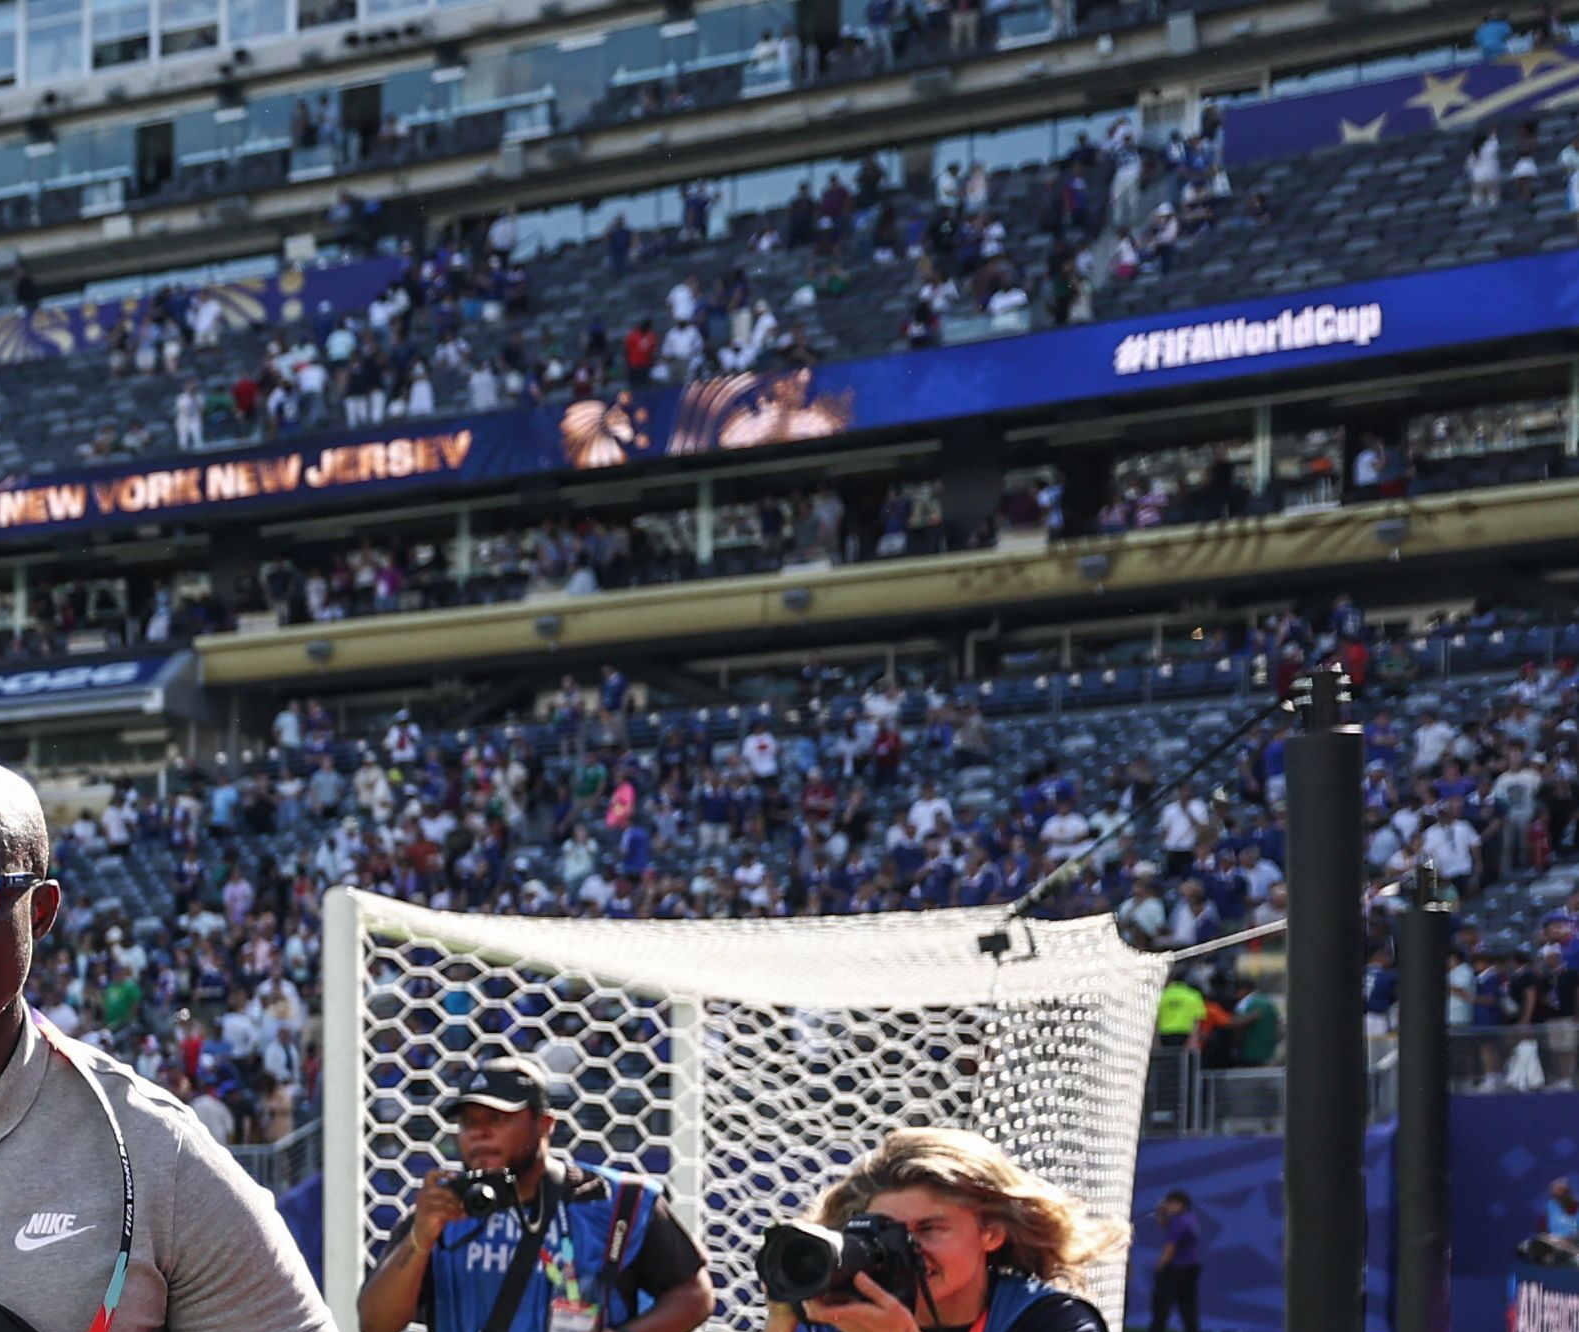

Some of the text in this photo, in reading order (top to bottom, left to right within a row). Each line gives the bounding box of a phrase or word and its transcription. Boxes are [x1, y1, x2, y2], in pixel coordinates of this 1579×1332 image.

[1112, 302, 1383, 376] #FIFAWorldCup
[91, 466, 202, 514] YORK
[205, 452, 303, 502] NEW
[304, 428, 474, 489] JERSEY
[24, 1212, 78, 1235] NIKE
[124, 1203, 134, 1237] FIFA
